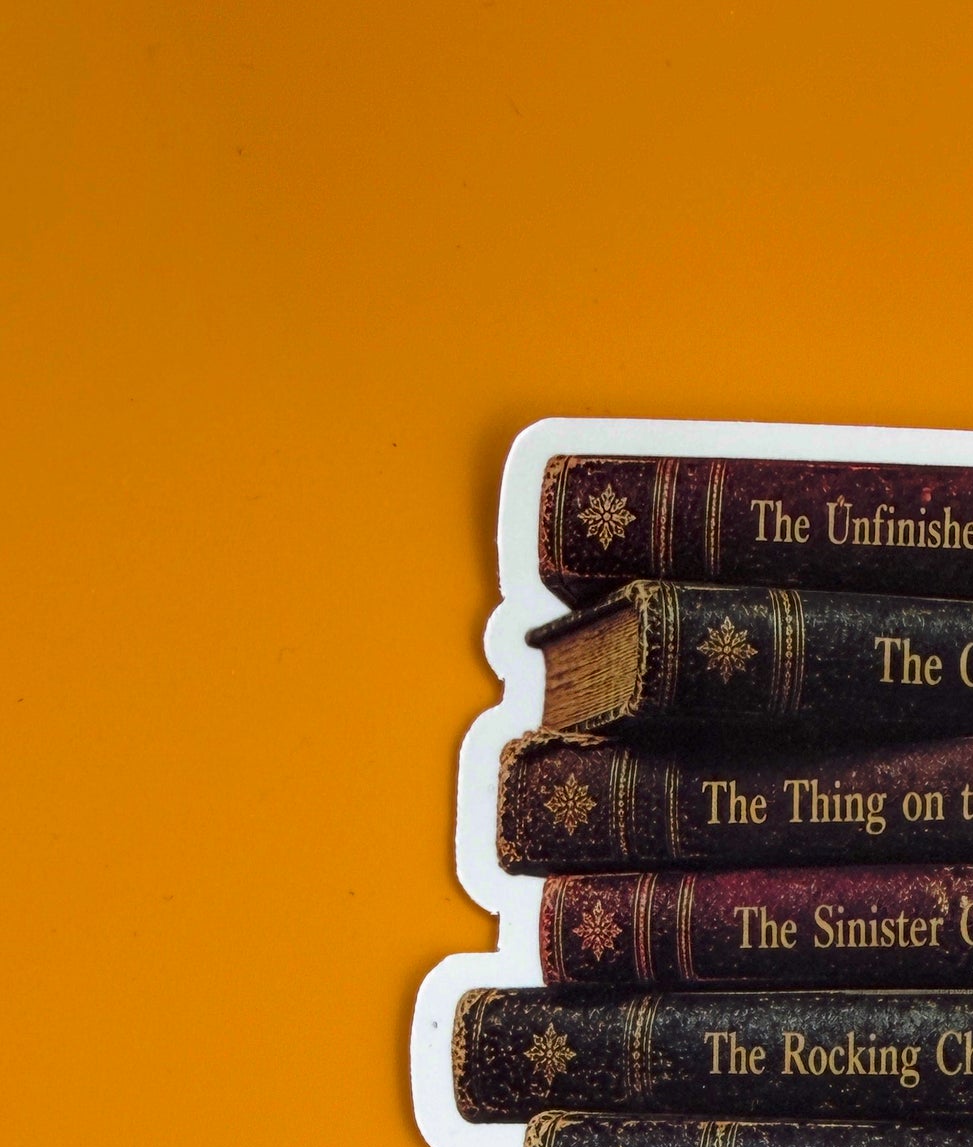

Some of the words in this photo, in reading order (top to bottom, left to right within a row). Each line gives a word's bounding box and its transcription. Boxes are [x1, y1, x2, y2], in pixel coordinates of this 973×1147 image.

[750, 499, 811, 544] The
[874, 636, 943, 686] The
[701, 779, 767, 825] The
[783, 778, 888, 835] Thing
[902, 791, 945, 822] on
[733, 905, 798, 949] The
[814, 903, 944, 949] Sinister
[703, 1030, 766, 1075] The
[780, 1030, 922, 1089] Rocking
